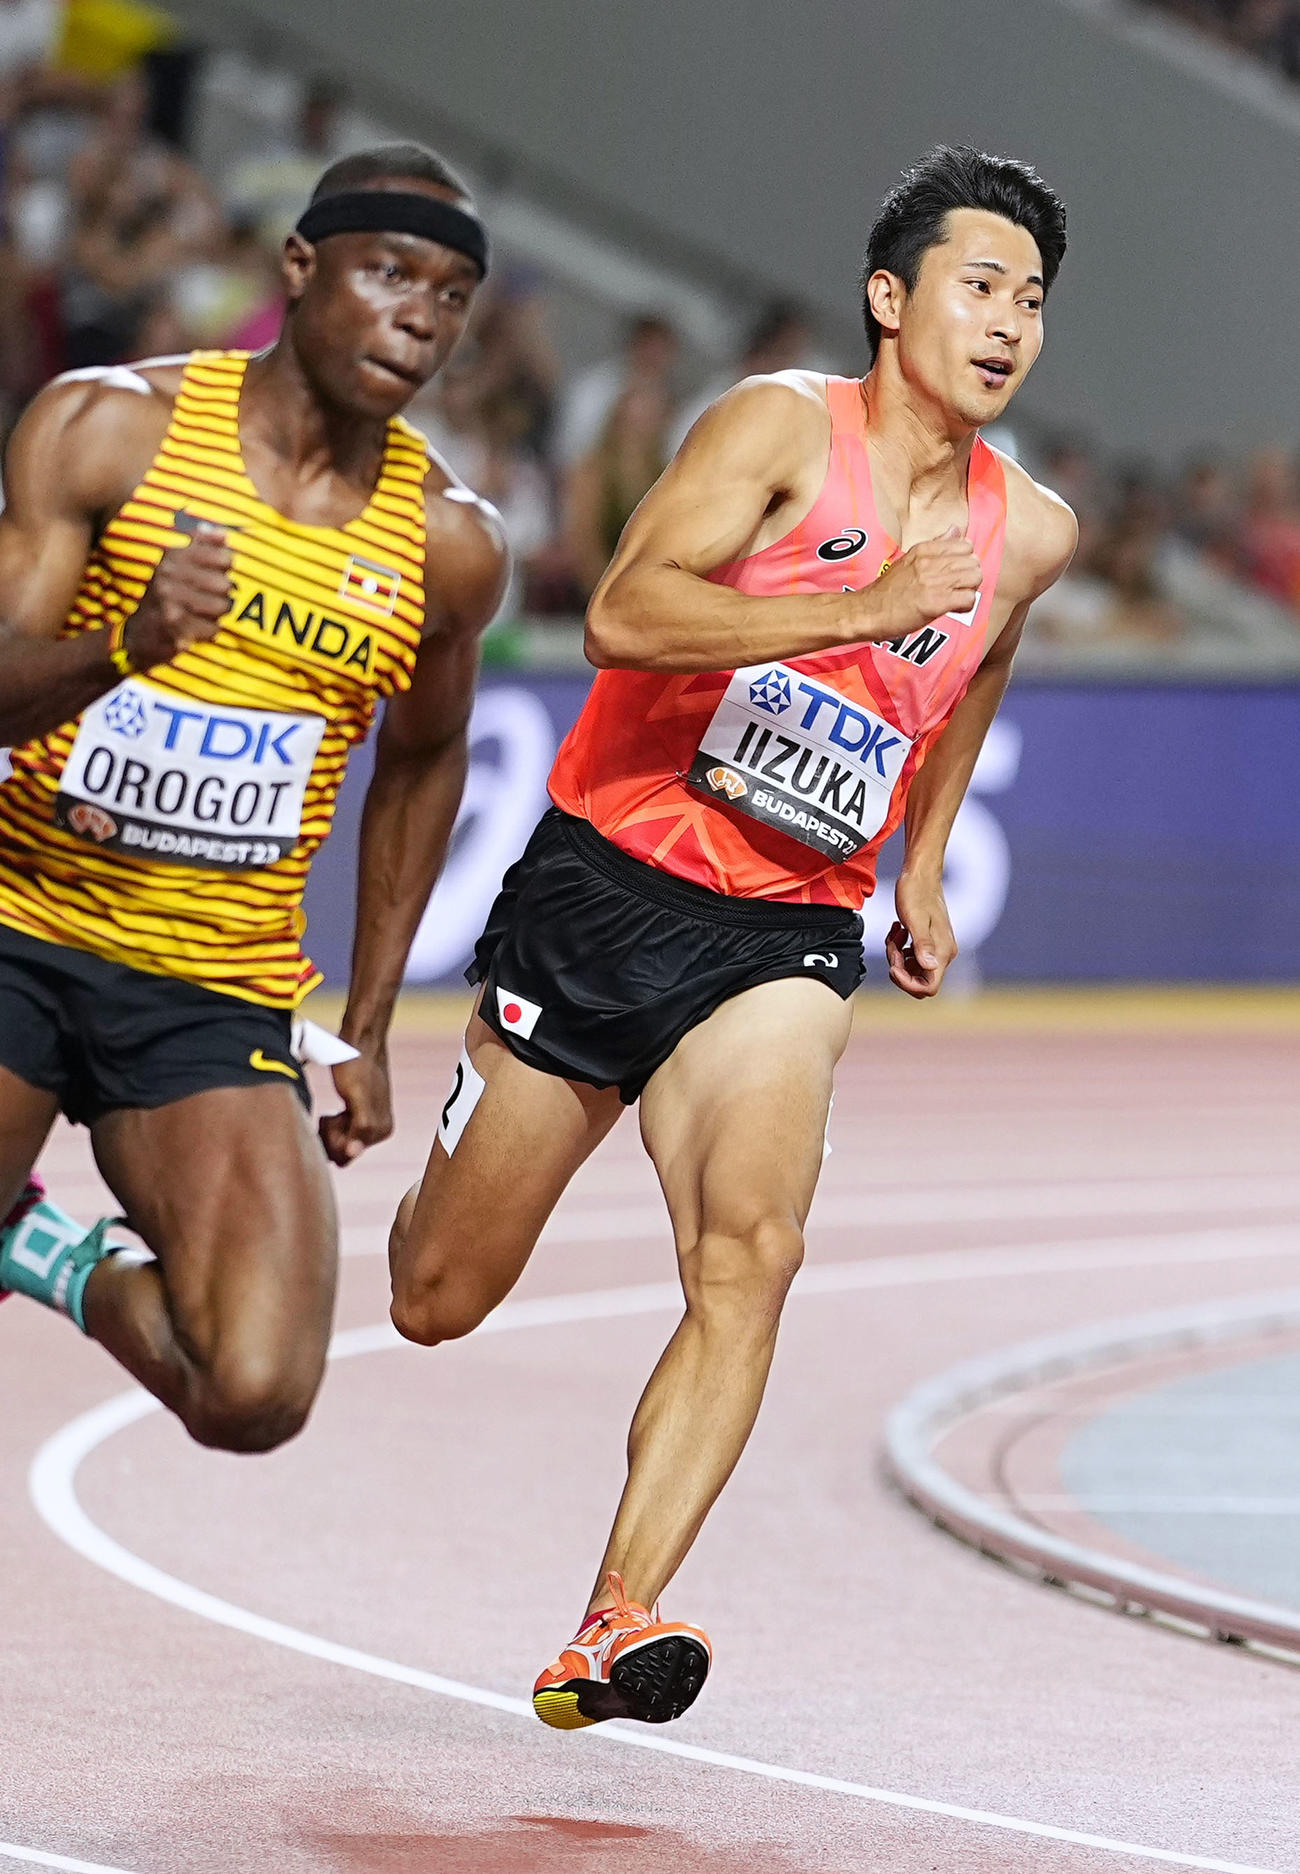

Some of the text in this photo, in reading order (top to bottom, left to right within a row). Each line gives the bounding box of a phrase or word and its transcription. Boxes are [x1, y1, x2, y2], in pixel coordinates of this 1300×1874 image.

[226, 582, 372, 674] ANDA
[153, 702, 302, 766] TDK
[732, 721, 868, 826] IIZUKA
[798, 681, 901, 778] TDK
[82, 747, 292, 826] OROGOT
